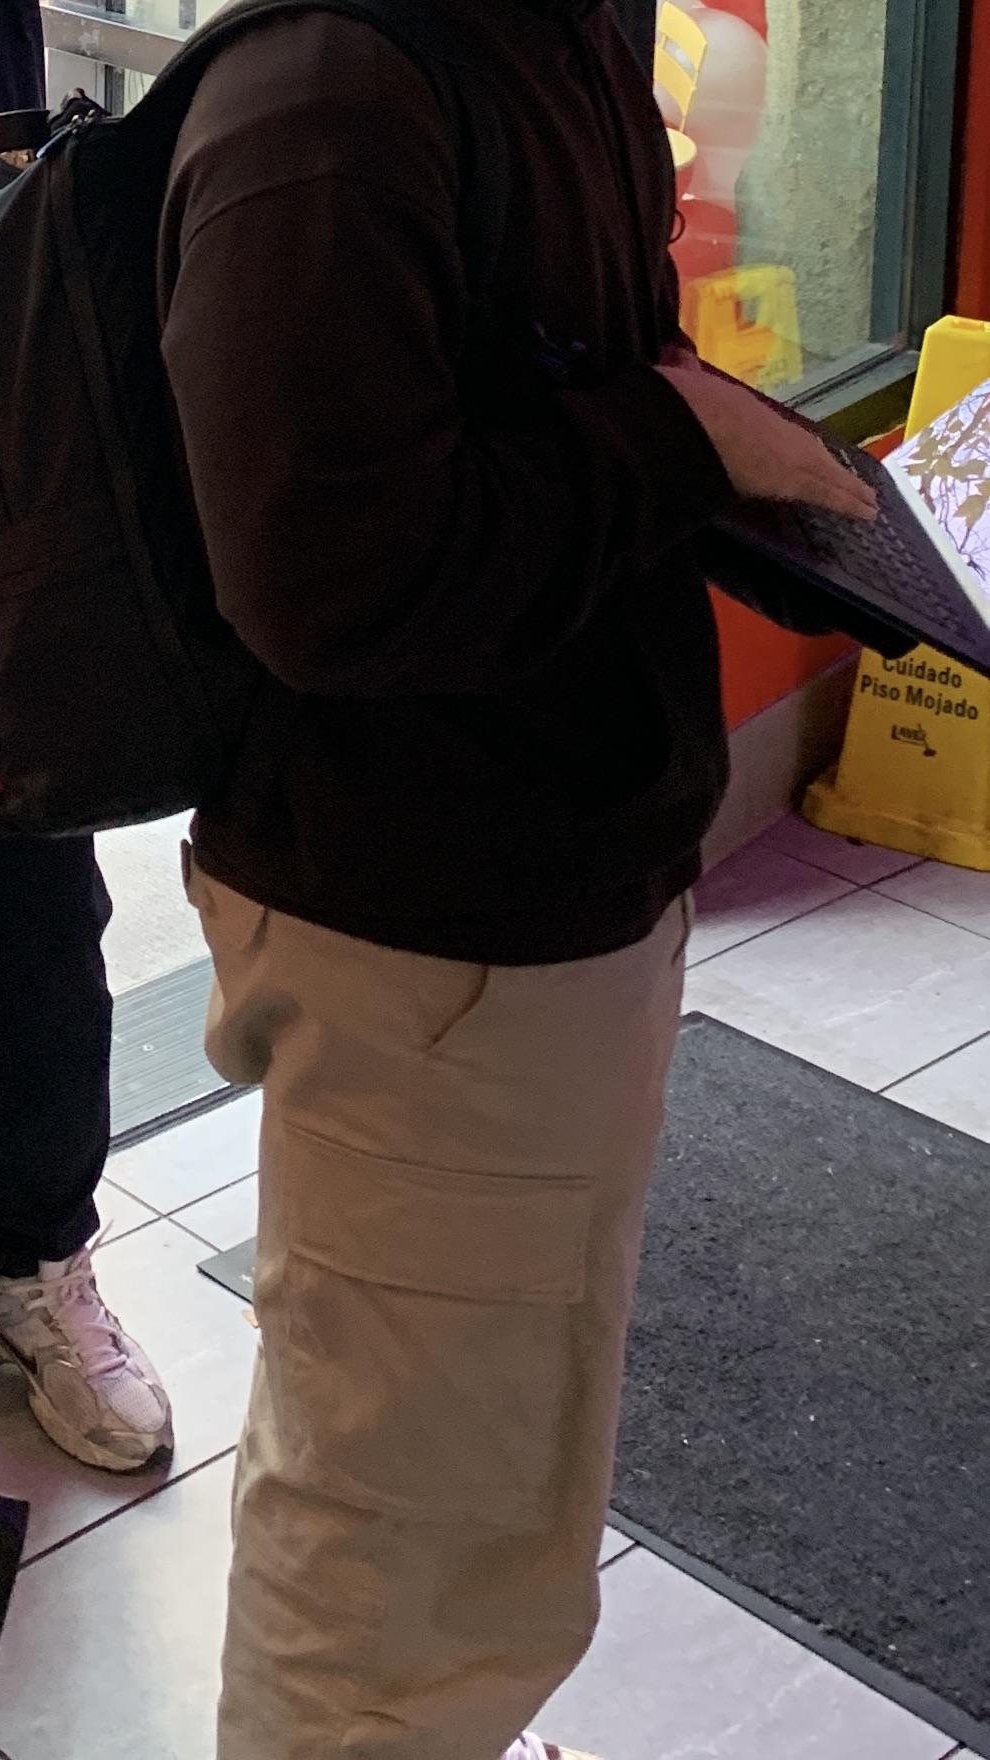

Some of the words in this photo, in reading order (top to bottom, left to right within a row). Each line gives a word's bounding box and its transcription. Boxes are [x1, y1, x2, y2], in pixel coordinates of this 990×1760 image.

[882, 657, 962, 689] Cuidado
[860, 674, 900, 701] Piso
[905, 685, 979, 721] Mojado
